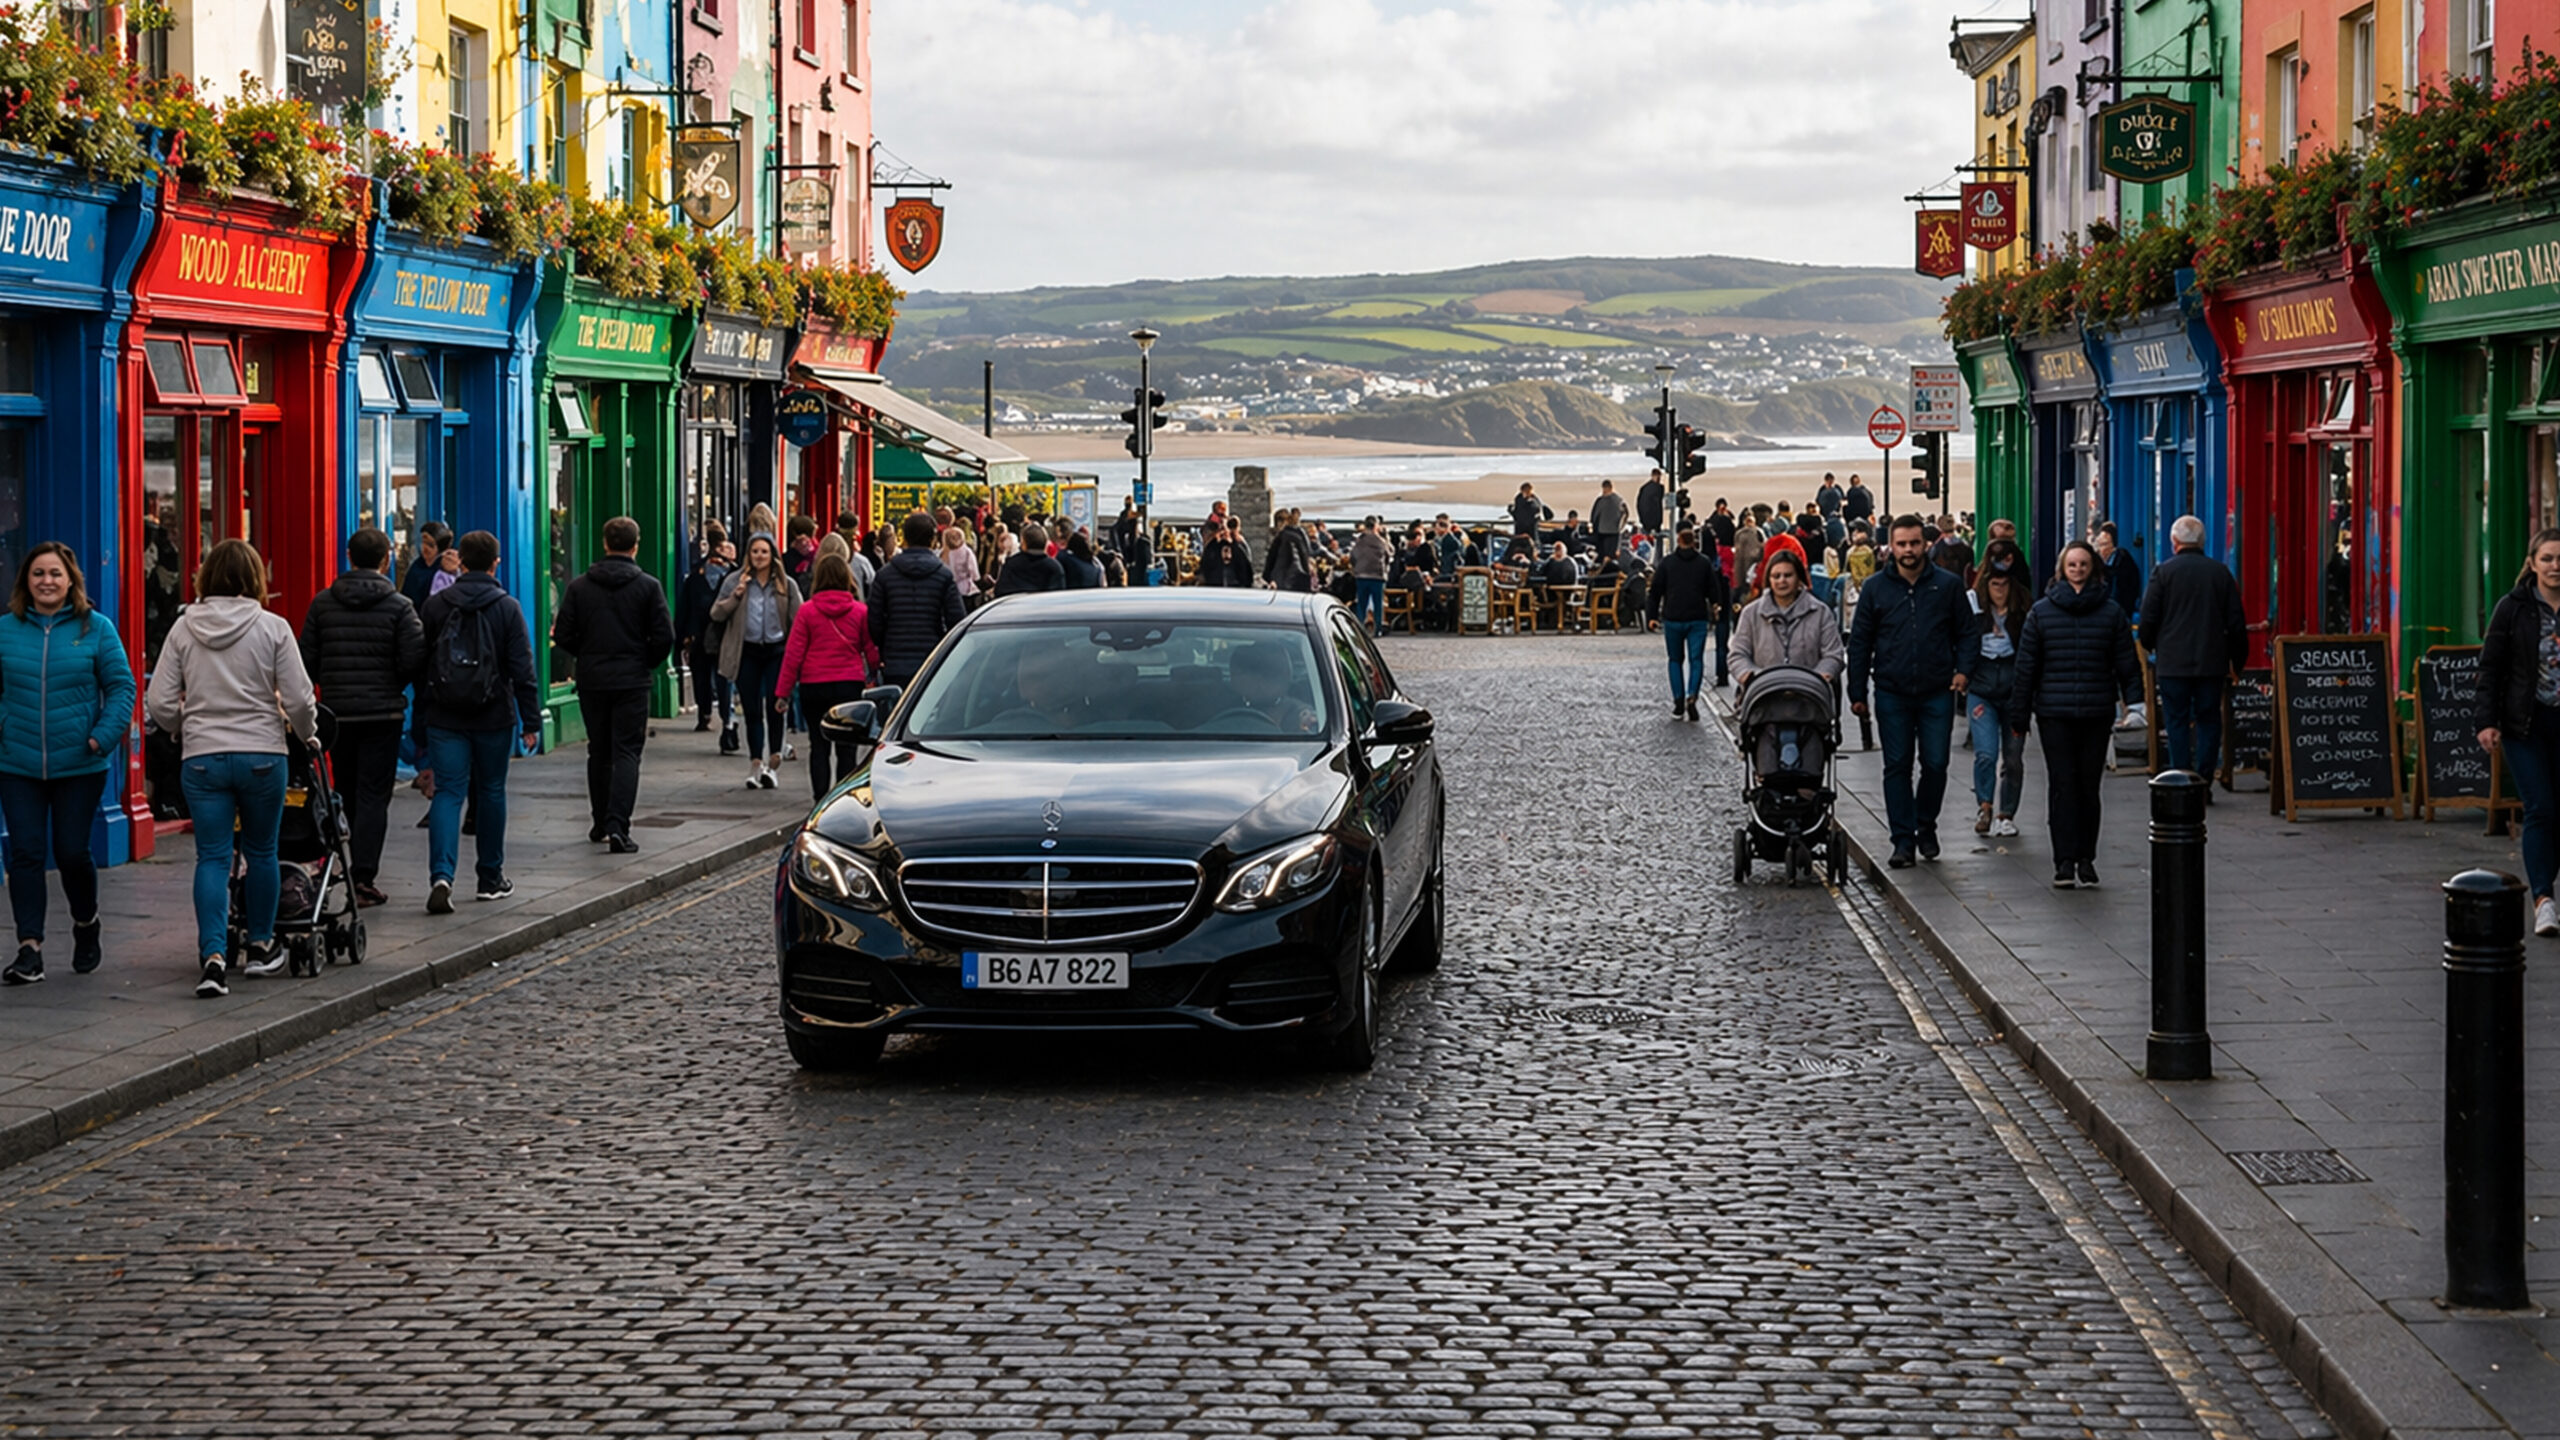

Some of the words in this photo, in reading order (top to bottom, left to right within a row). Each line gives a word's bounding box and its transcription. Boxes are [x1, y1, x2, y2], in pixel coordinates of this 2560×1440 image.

[20, 209, 71, 263] DOOR
[178, 233, 230, 285] WOOD
[233, 243, 311, 296] ALCHEMY
[2426, 261, 2462, 304] ARAN
[2461, 248, 2528, 298] SWEATER
[988, 958, 1022, 984] B6
[1026, 958, 1061, 985] A7
[1066, 958, 1117, 985] 822
